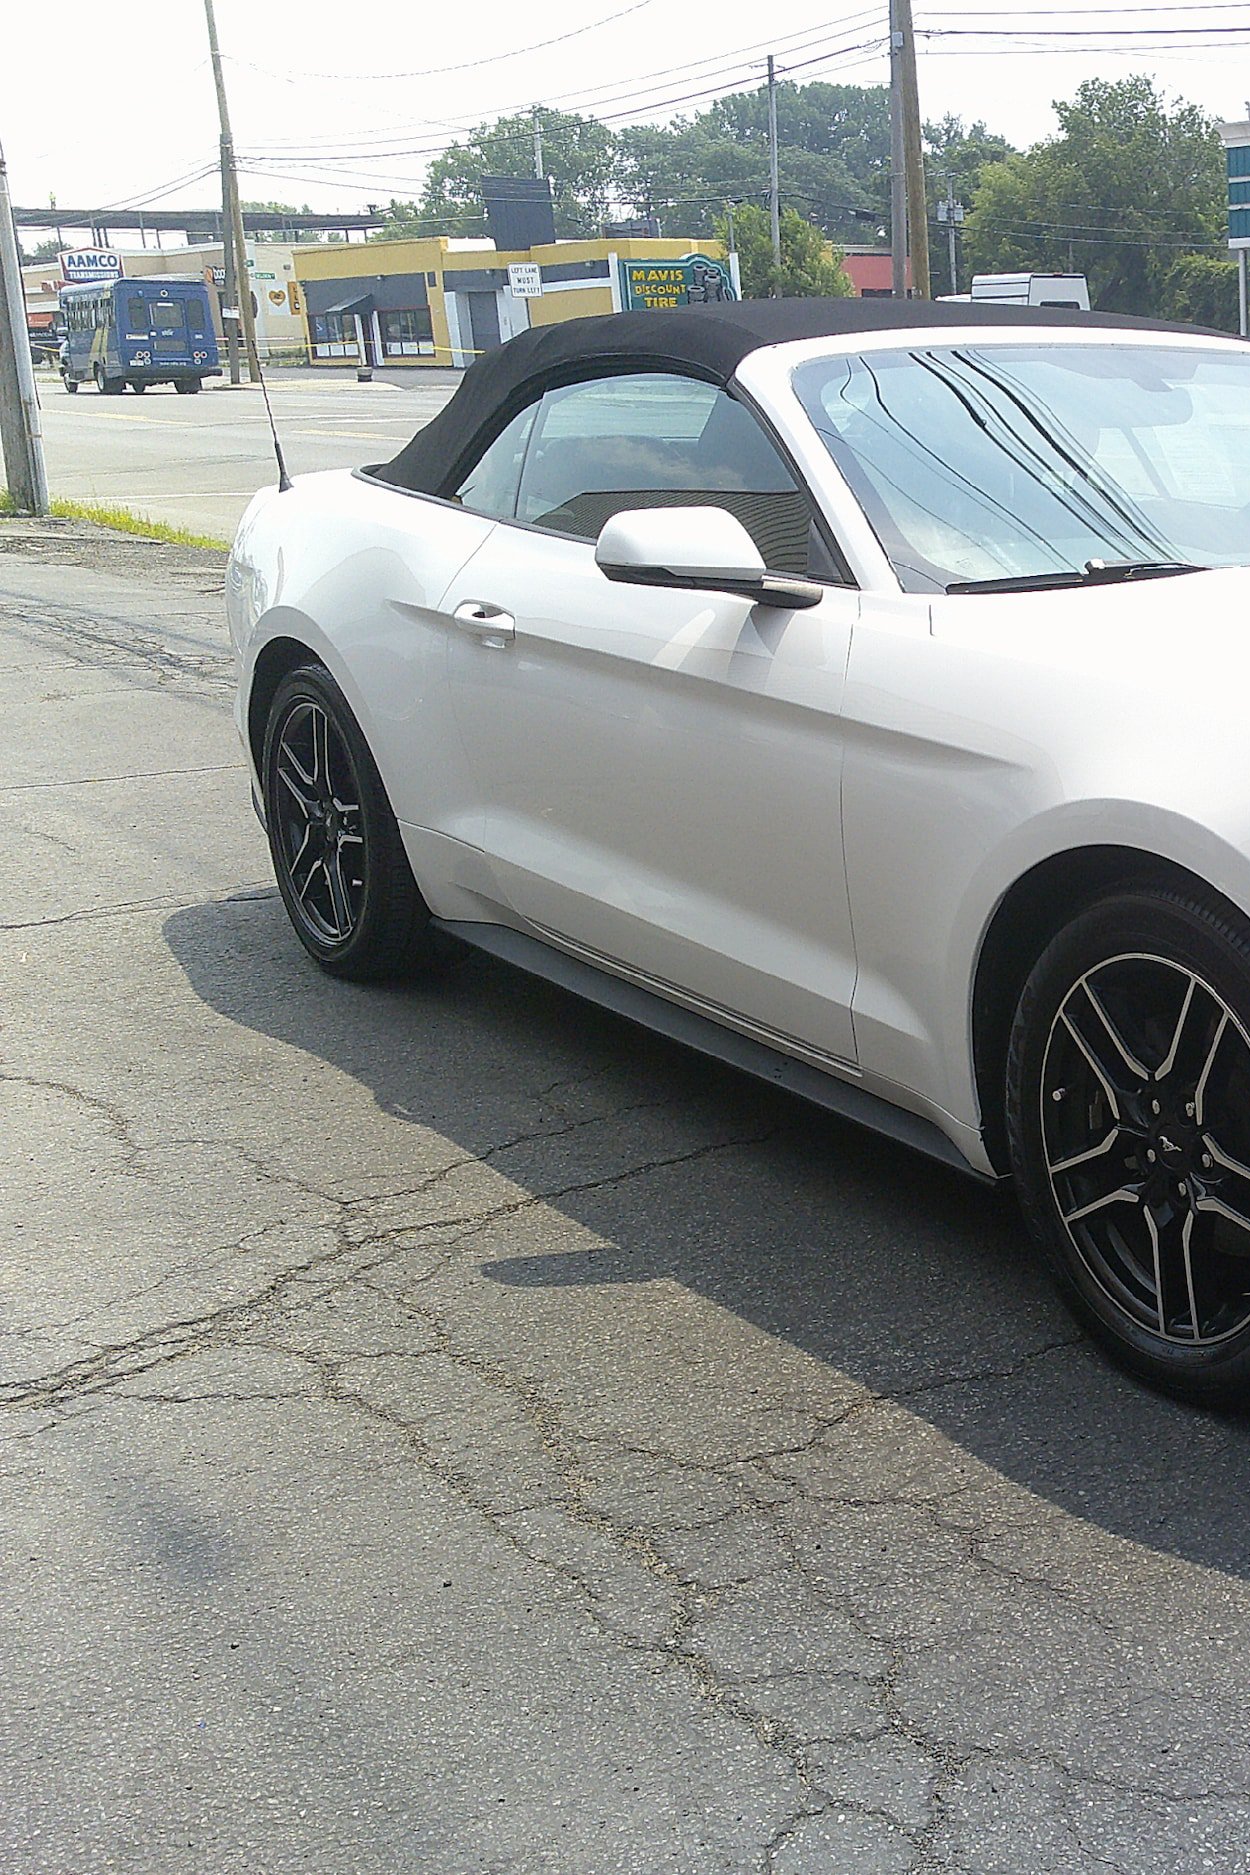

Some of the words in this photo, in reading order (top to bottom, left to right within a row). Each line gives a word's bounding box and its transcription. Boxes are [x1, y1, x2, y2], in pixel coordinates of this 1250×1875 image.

[67, 255, 118, 268] AAMCO
[212, 266, 226, 279] boo
[632, 269, 684, 281] MAVIS
[516, 276, 534, 284] MUST
[634, 284, 687, 296] DISCOUNT
[643, 297, 678, 308] TIRE
